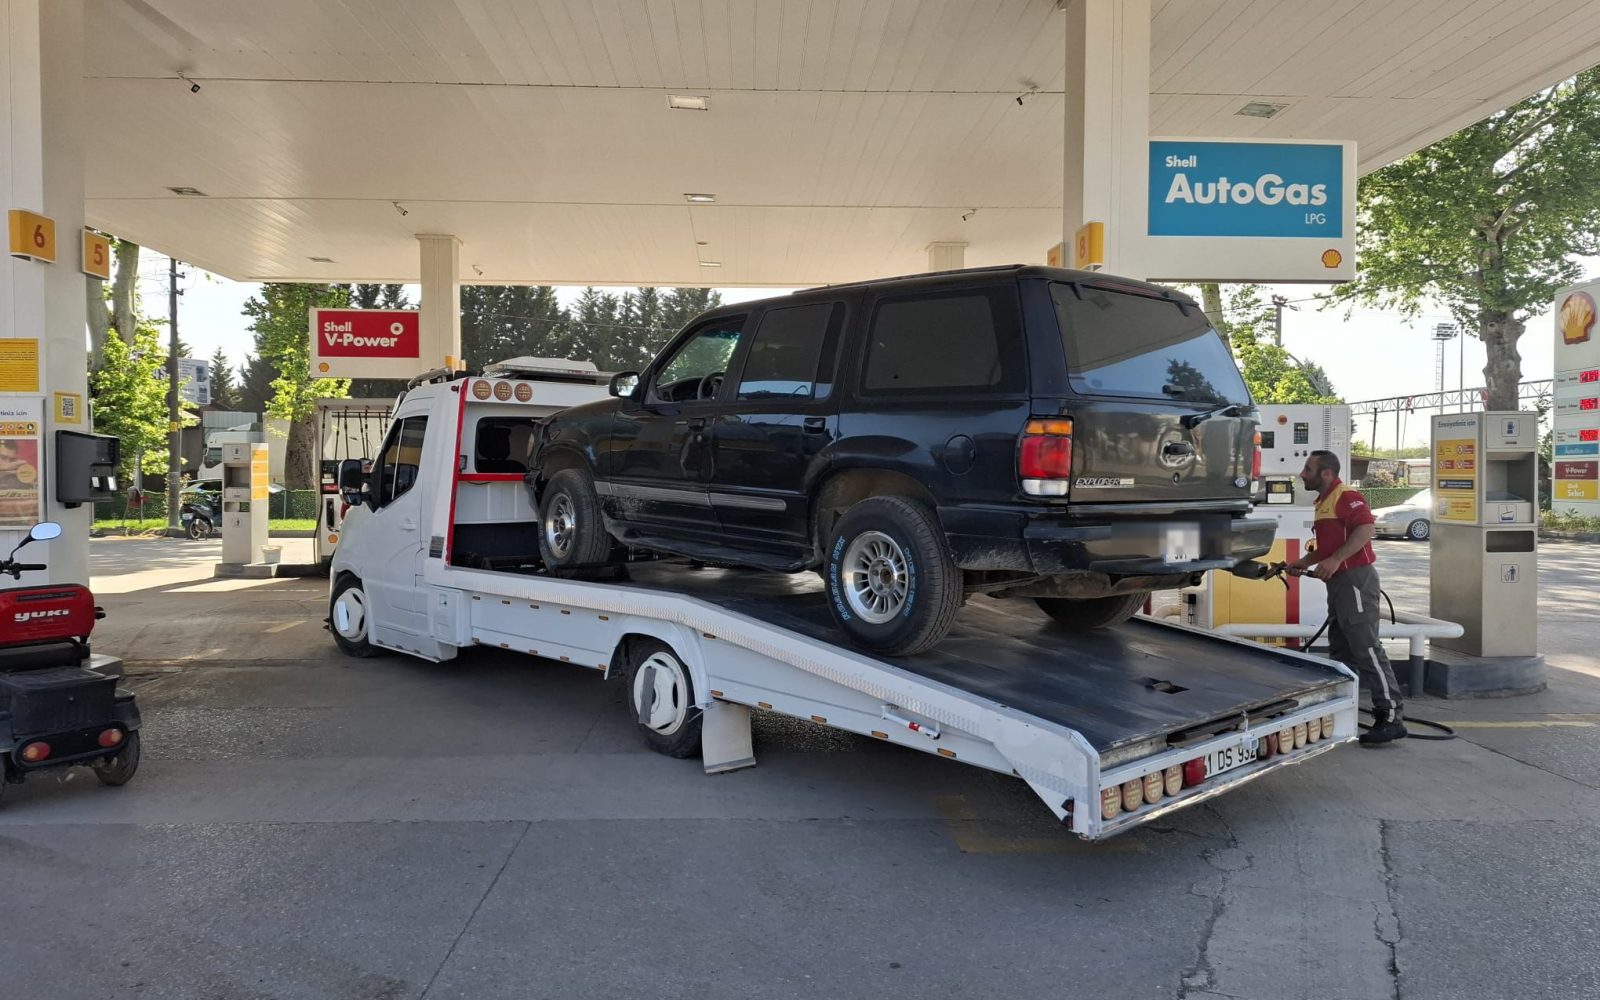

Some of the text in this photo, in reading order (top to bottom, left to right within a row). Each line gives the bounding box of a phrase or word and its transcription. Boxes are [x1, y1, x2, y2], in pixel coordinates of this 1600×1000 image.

[1165, 155, 1197, 168] Shell
[1165, 173, 1328, 206] AutoGas
[1305, 213, 1326, 225] LPG
[33, 224, 45, 249] 6
[93, 243, 104, 266] 5
[1079, 236, 1086, 259] 8
[324, 321, 352, 332] Shell
[324, 332, 398, 347] V-Power
[1075, 477, 1121, 486] EXPLORER
[1217, 747, 1233, 771] DS
